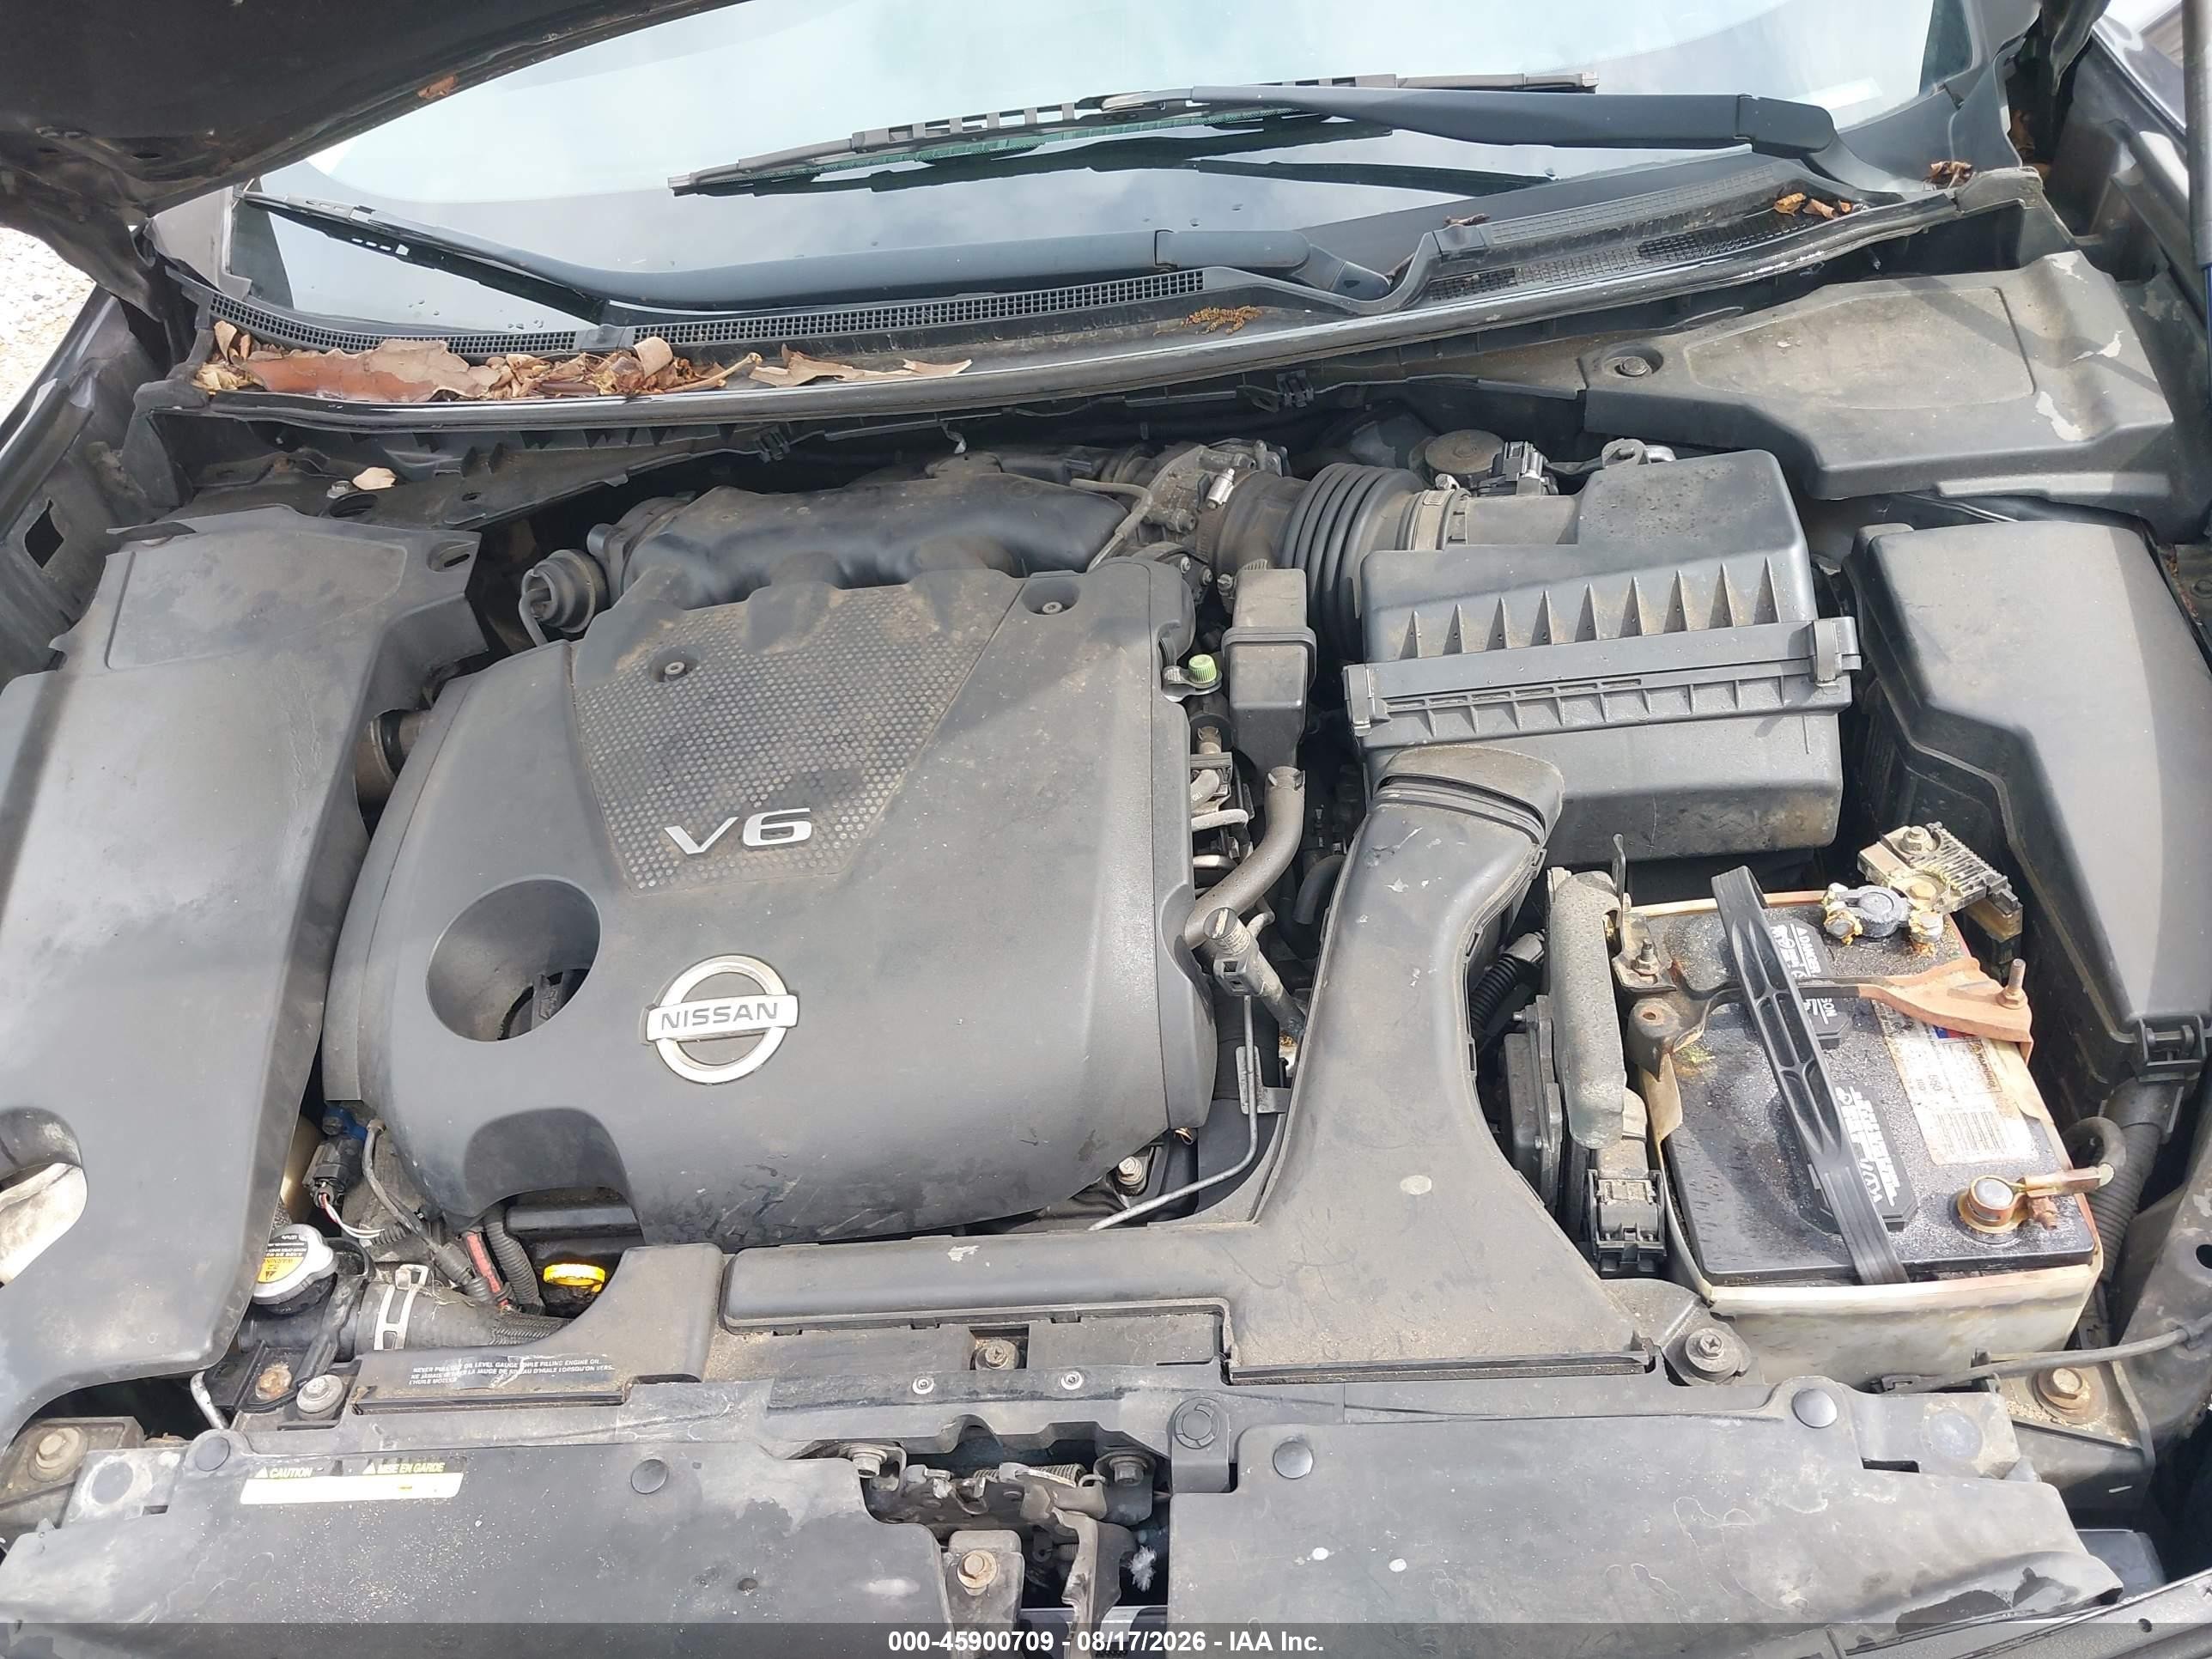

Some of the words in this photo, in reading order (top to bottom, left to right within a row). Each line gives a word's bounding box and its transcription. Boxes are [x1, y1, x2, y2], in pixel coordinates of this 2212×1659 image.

[664, 807, 812, 856] V6
[660, 1001, 779, 1031] NISSAN
[269, 1467, 313, 1478] CAUTION
[377, 1463, 398, 1474] MISE
[398, 1463, 412, 1473] EN
[413, 1462, 446, 1473] GARDE
